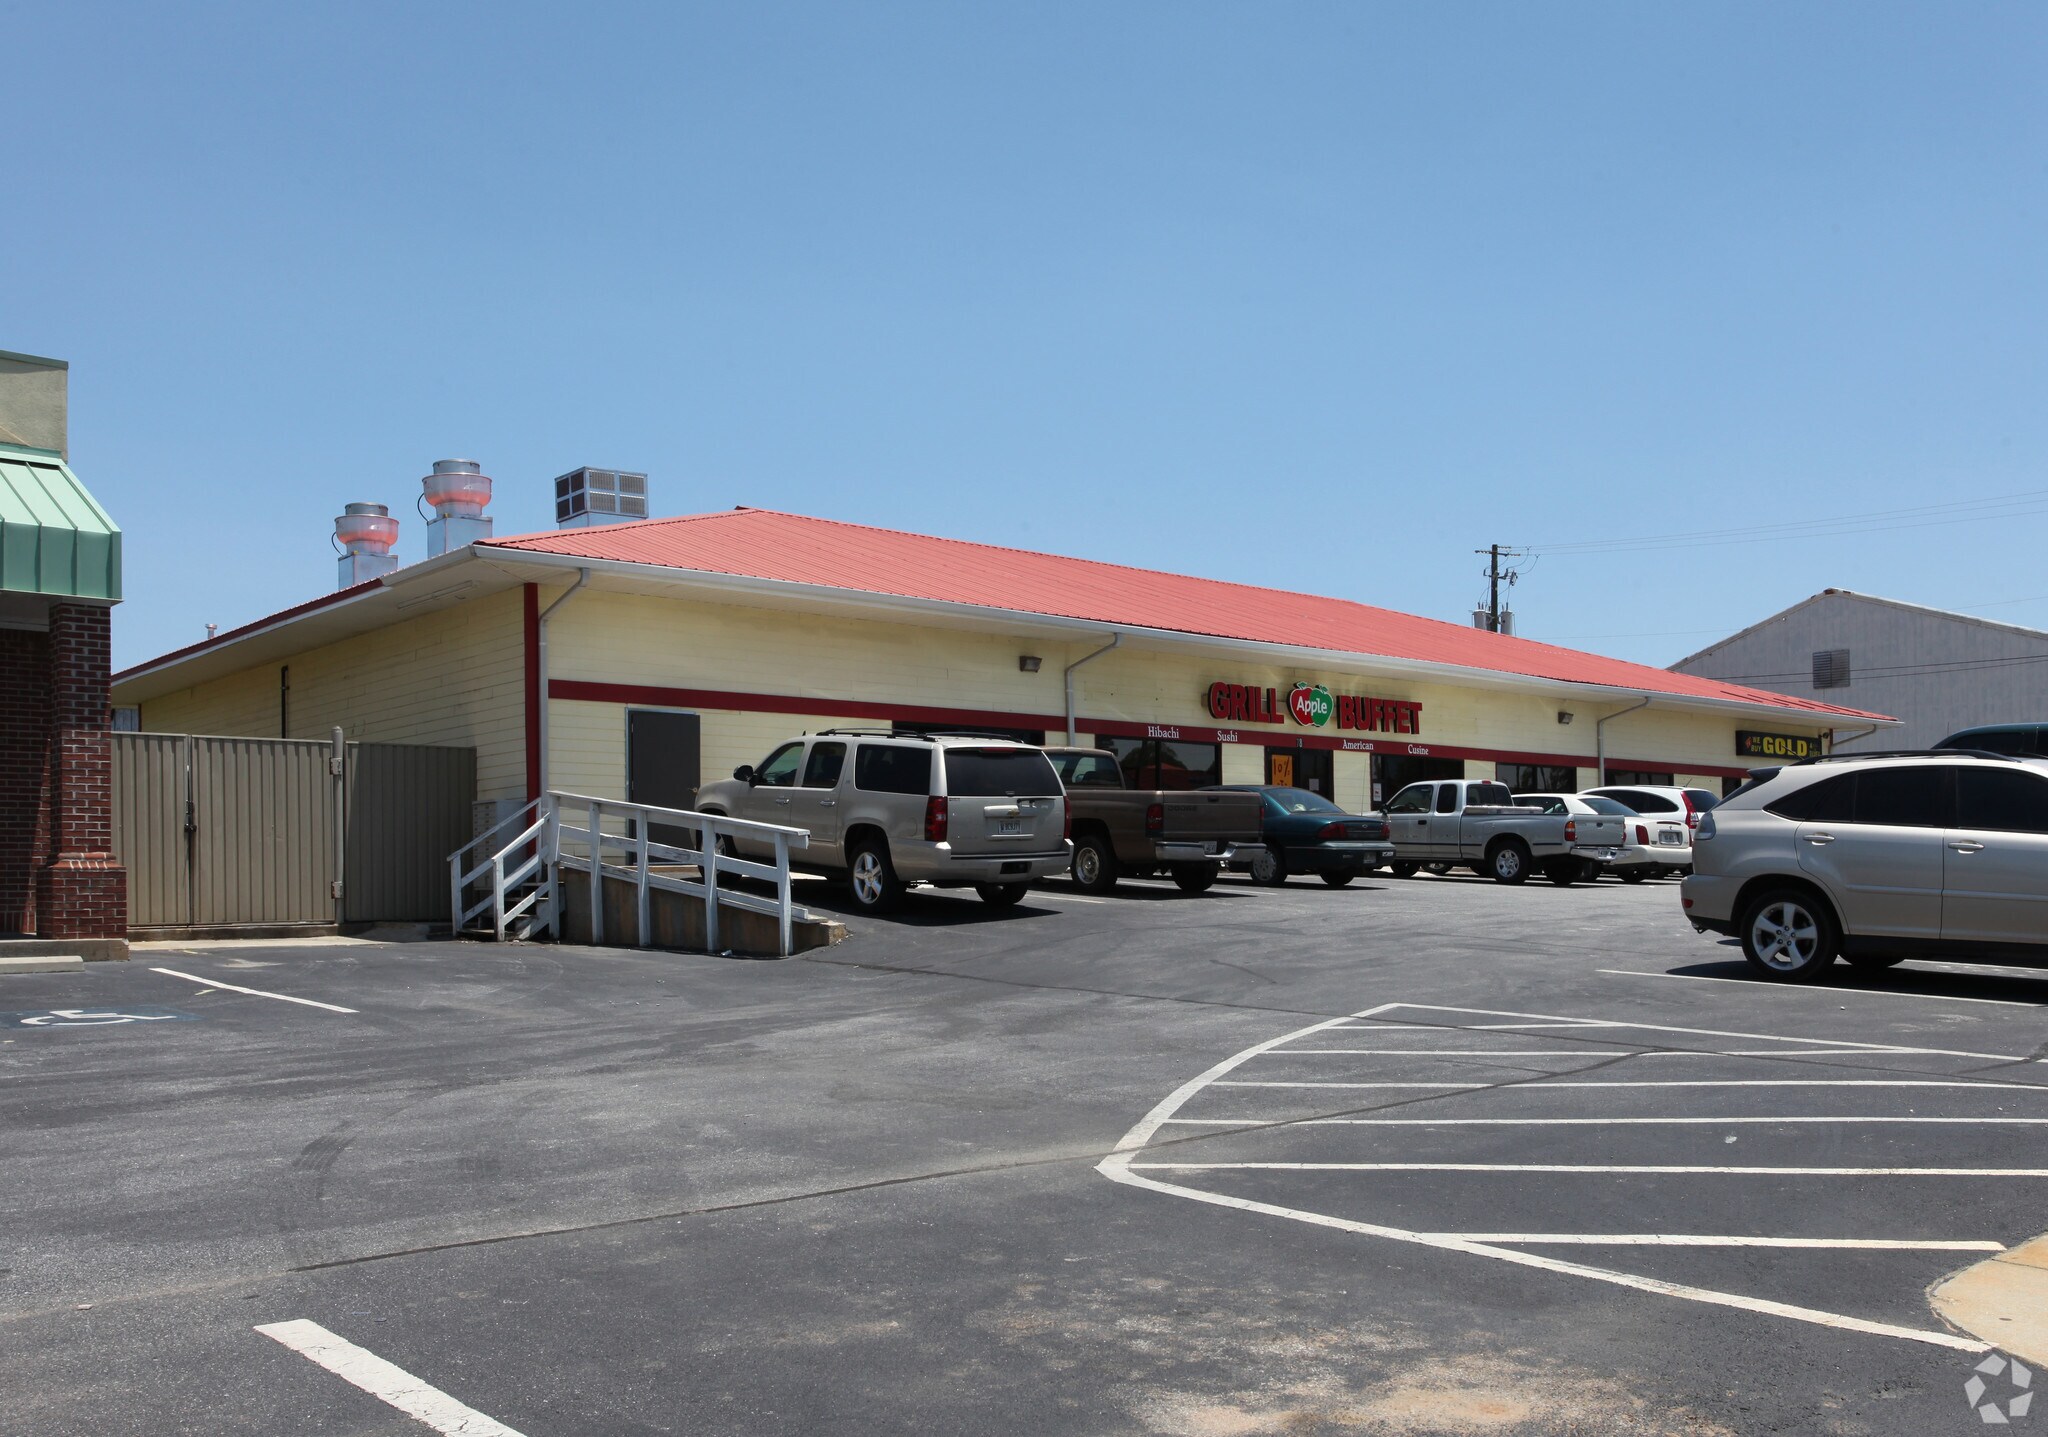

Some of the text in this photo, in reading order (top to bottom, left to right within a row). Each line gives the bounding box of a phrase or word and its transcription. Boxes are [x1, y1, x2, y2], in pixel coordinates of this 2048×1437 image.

[1209, 682, 1423, 734] GRILL Apple BUFFET
[1147, 725, 1429, 756] Hibachi Sushi American Cusine
[1763, 737, 1808, 757] GOLD
[1273, 756, 1291, 777] 10%
